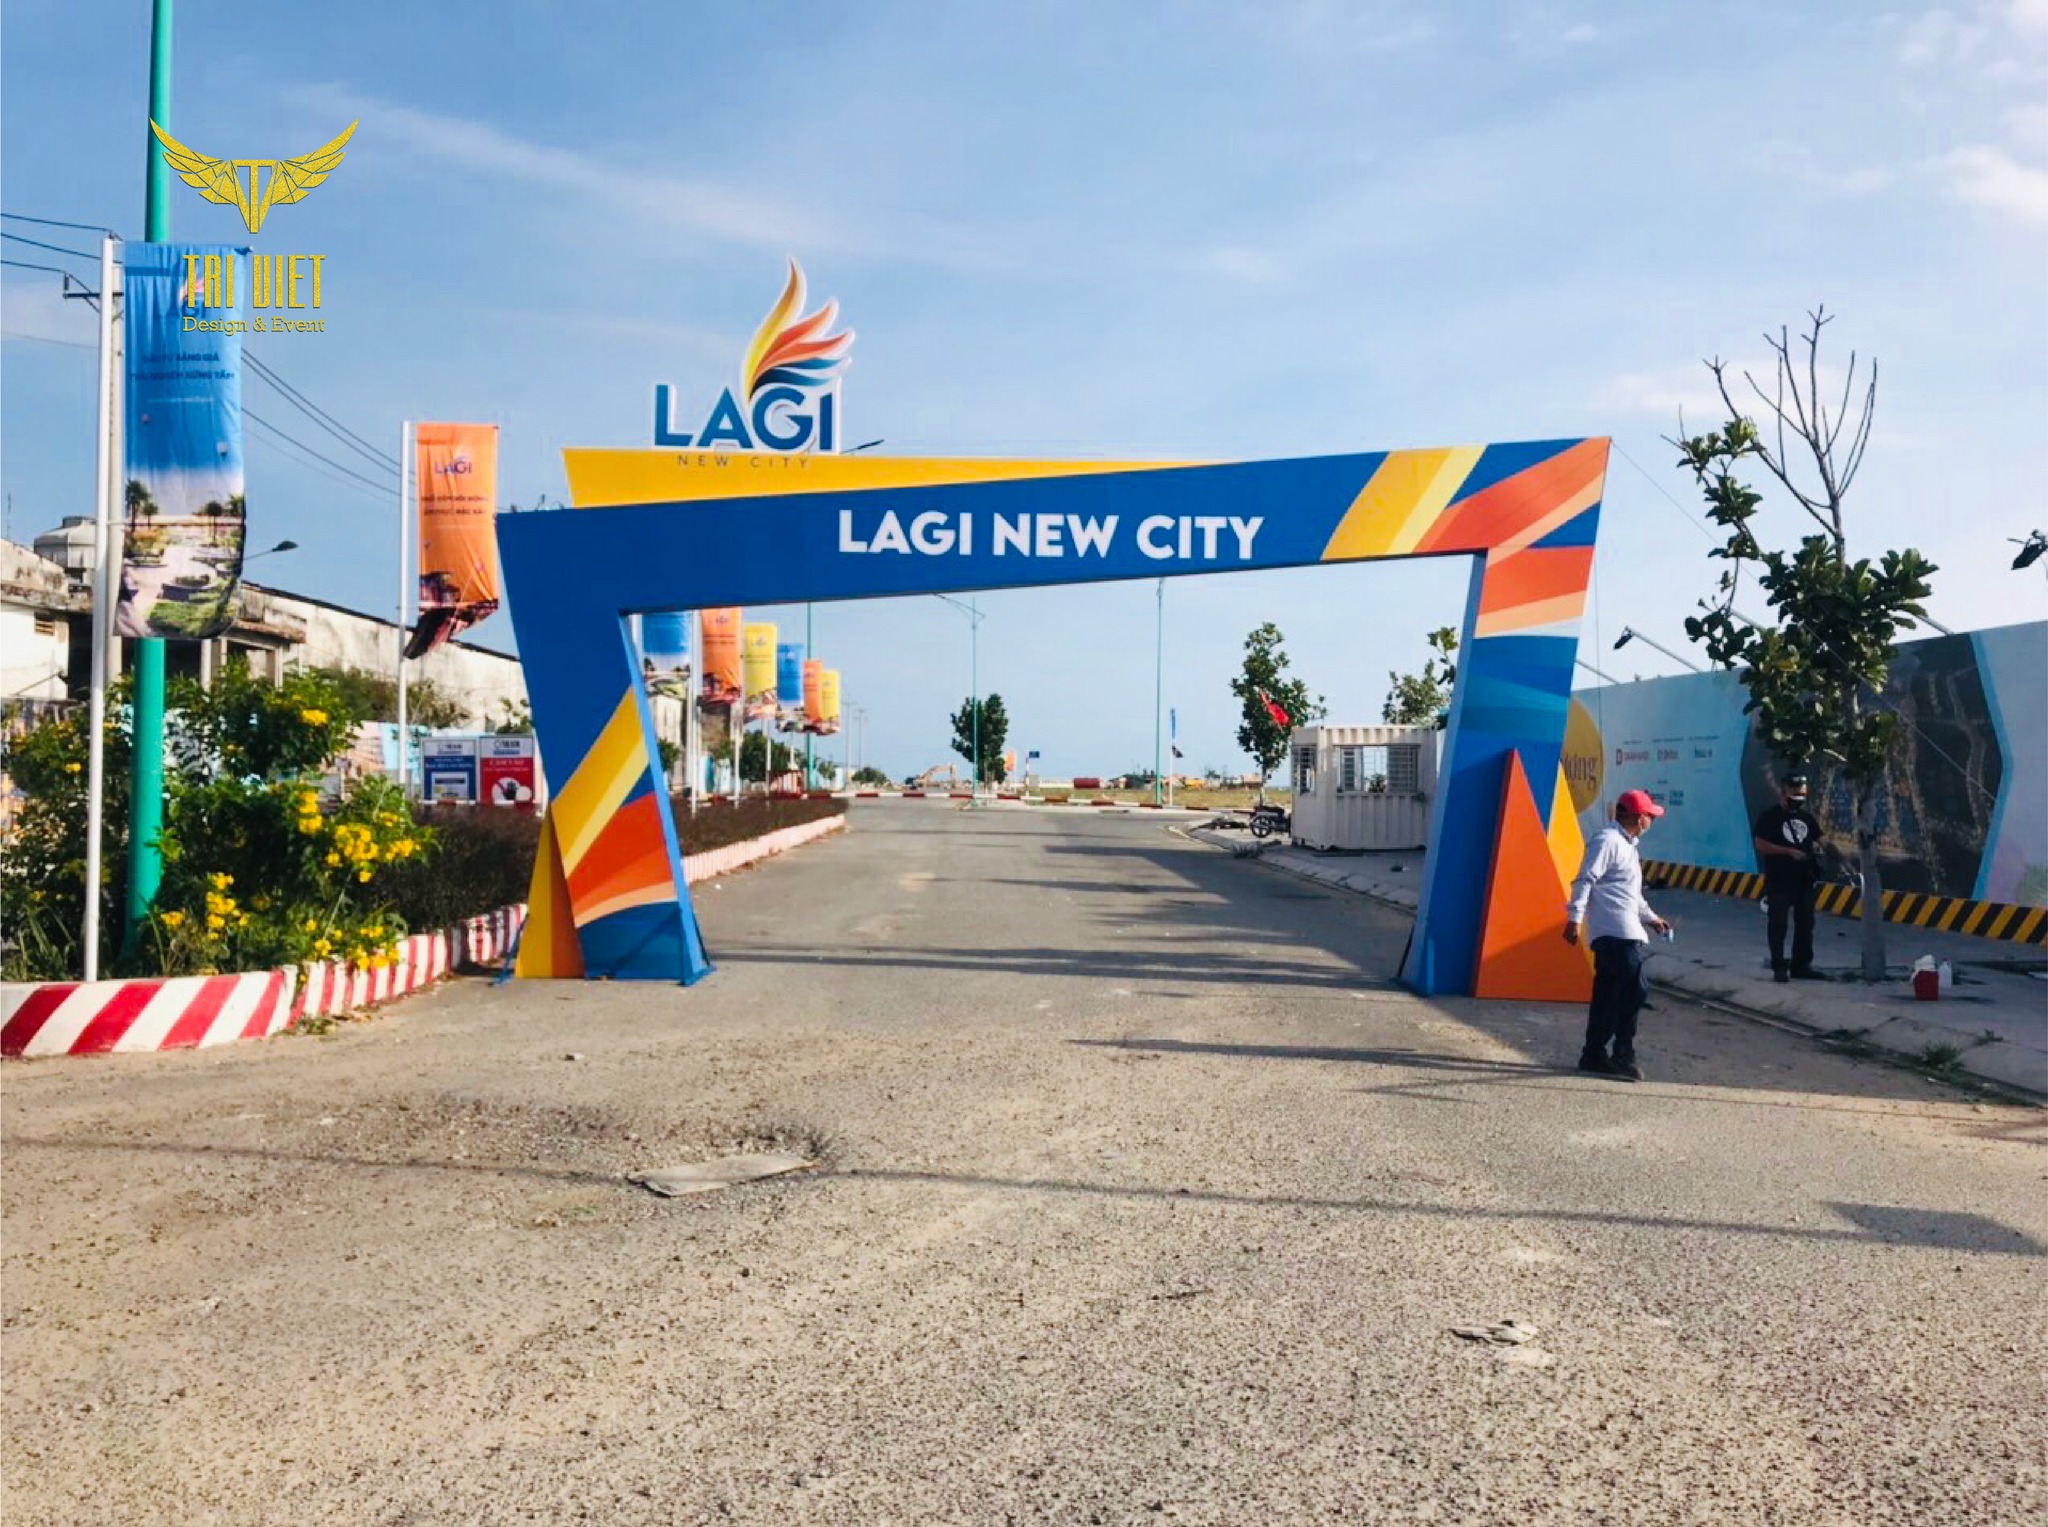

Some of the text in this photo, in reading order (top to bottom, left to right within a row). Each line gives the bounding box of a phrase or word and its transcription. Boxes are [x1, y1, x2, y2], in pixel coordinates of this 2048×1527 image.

[654, 384, 833, 450] LAGI
[434, 460, 473, 474] LAGI
[677, 455, 808, 468] NEW CITY
[838, 508, 1267, 560] LAGI NEW CITY
